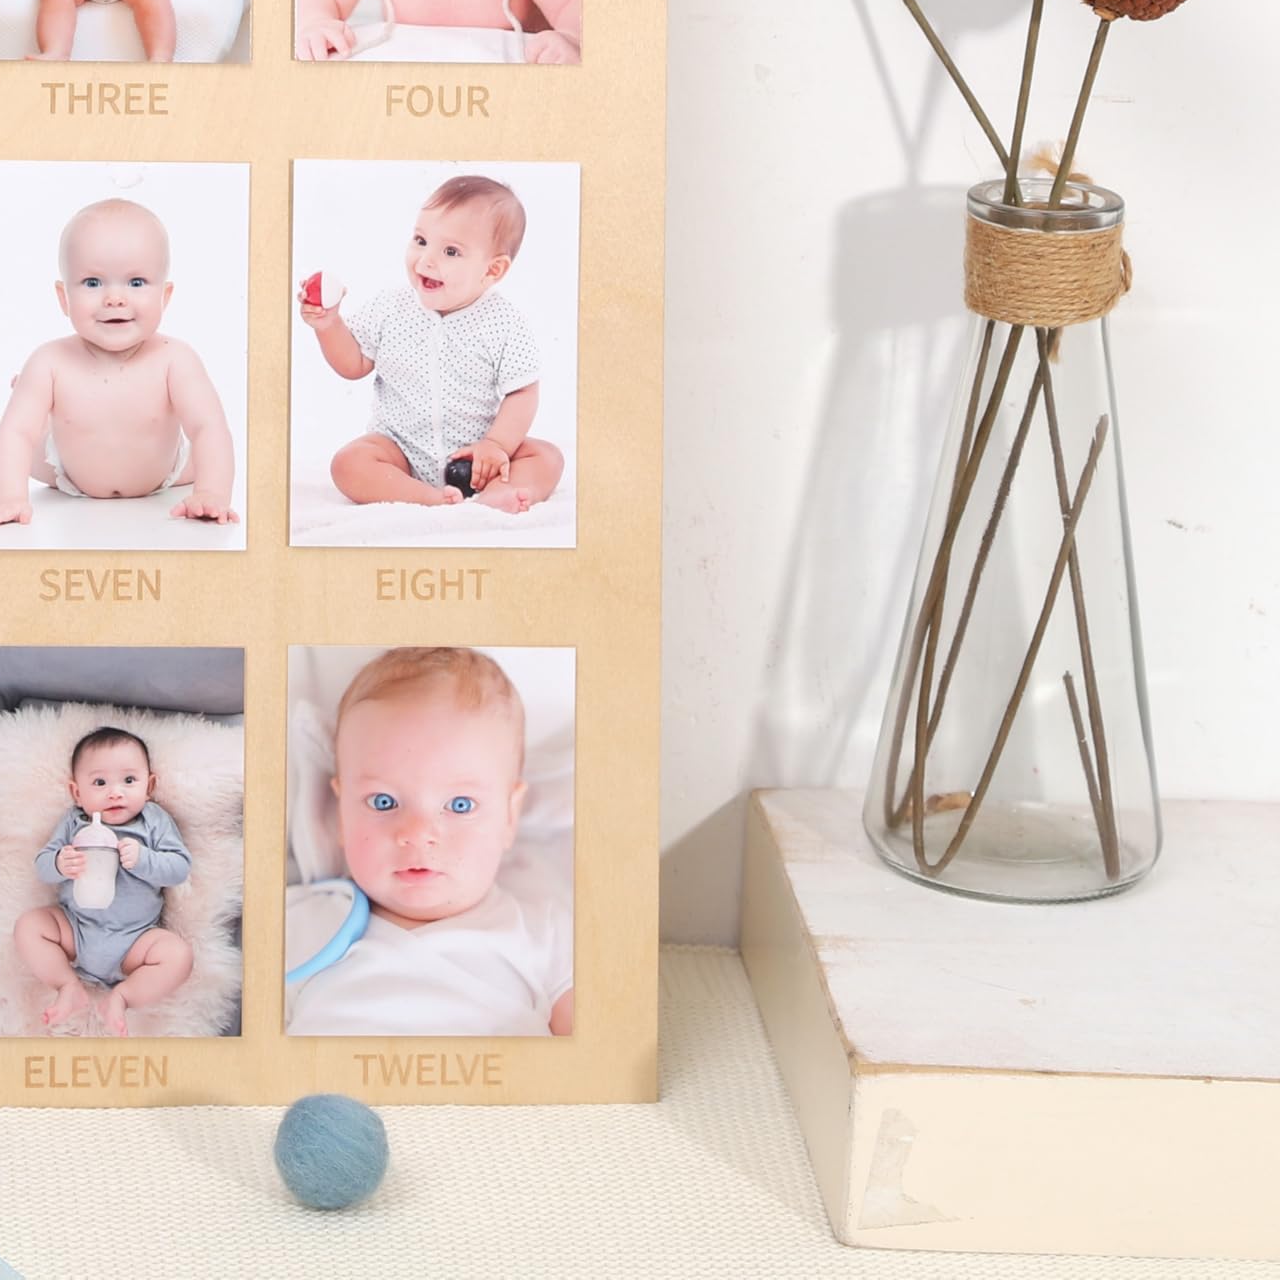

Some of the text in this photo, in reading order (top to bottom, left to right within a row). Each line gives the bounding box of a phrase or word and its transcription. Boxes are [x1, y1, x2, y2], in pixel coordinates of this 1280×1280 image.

[41, 82, 169, 116] THREE
[385, 84, 490, 118] FOUR
[39, 568, 162, 602] SEVEN
[376, 568, 491, 601] EIGHT
[24, 1055, 169, 1089] ELEVEN
[354, 1053, 504, 1086] TWELVE
